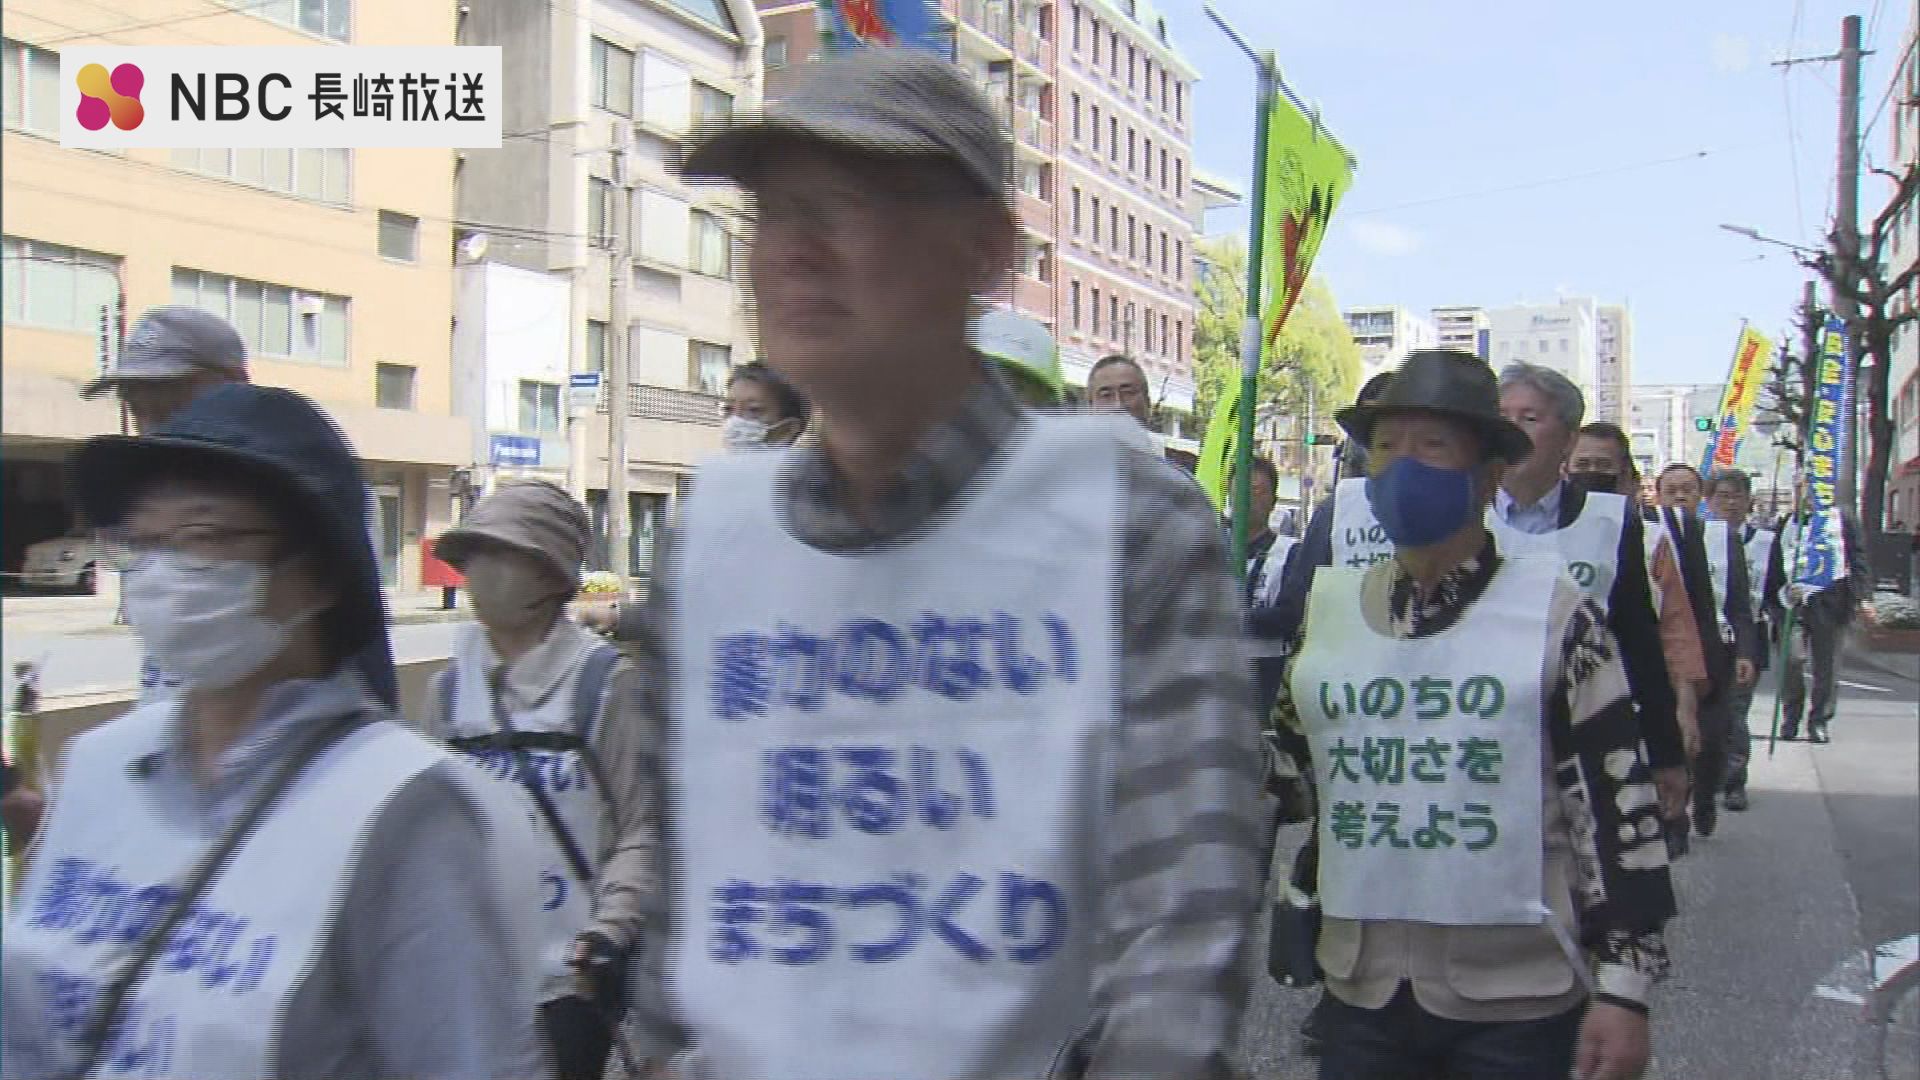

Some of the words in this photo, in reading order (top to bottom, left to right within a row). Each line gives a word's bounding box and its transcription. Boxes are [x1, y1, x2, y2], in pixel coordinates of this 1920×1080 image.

[1319, 675, 1505, 720] いのちの
[1328, 735, 1504, 784] 大切さを
[1331, 800, 1498, 851] 考えよう
[711, 872, 1068, 964] まちづくり
